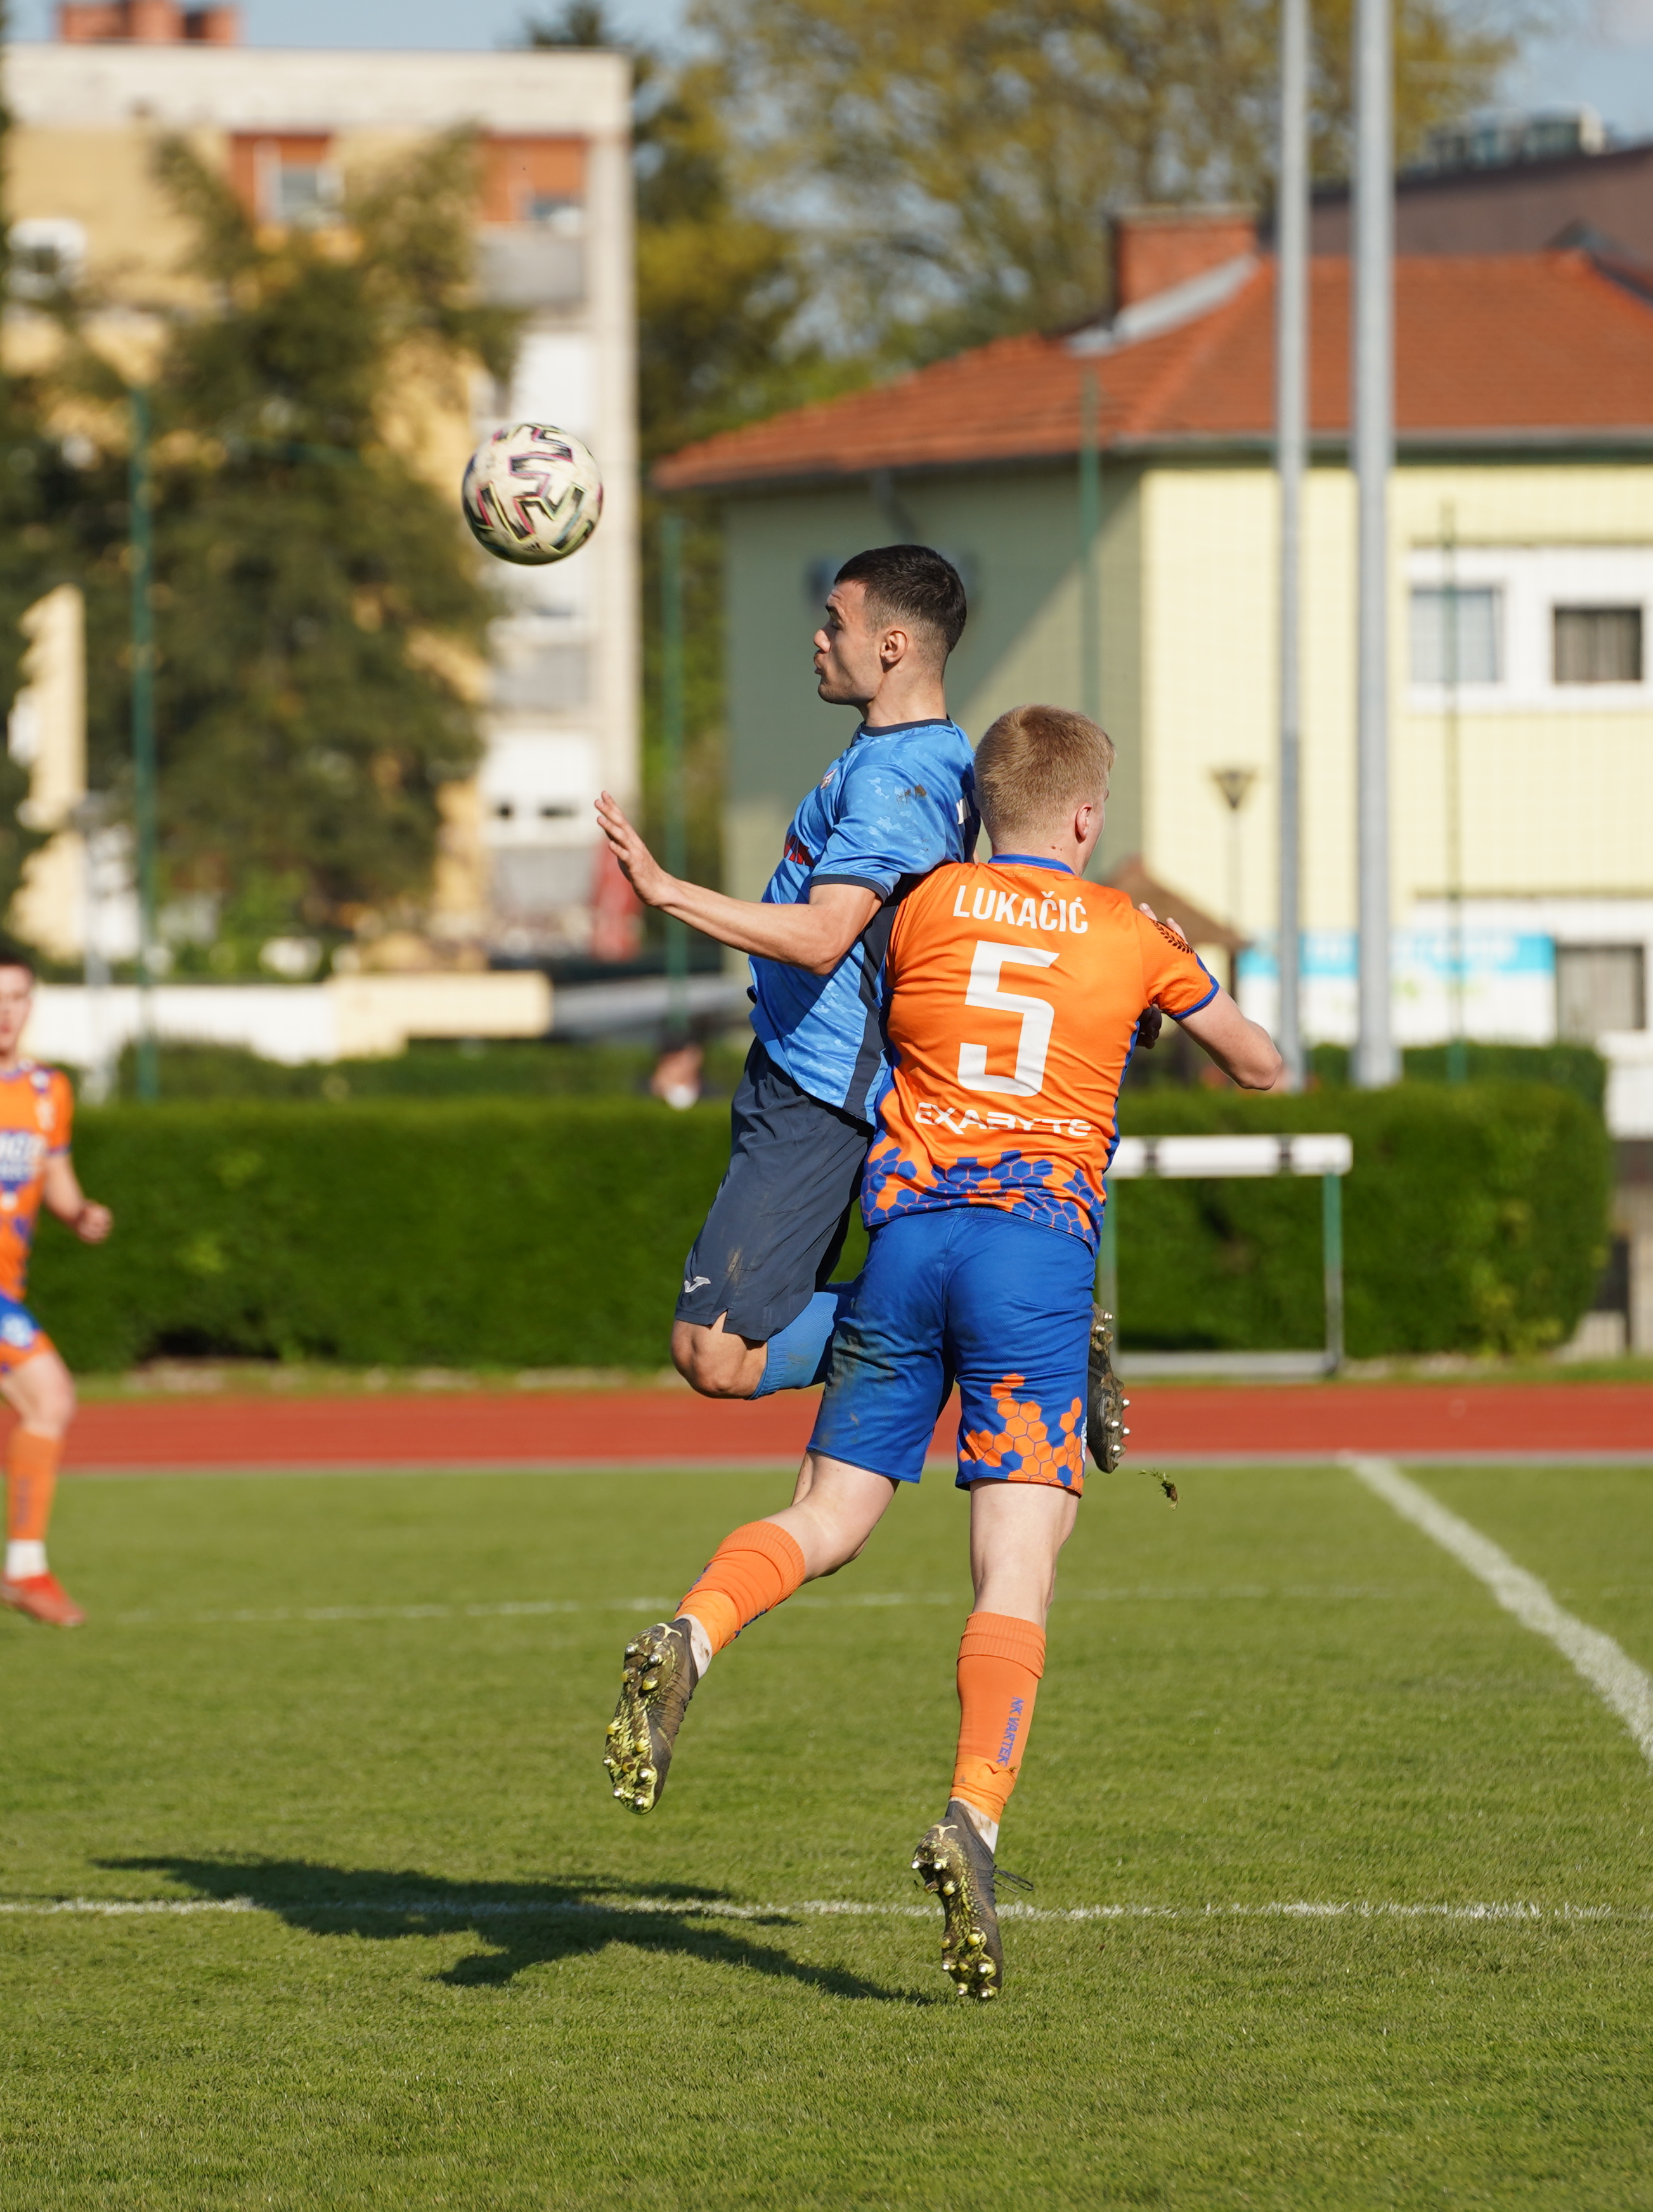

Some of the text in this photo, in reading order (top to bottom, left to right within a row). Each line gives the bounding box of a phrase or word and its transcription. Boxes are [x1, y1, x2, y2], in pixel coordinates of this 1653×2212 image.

[952, 885, 1088, 934] LUKAČIĆ
[957, 940, 1060, 1097] 5
[915, 1102, 1091, 1136] EXABYTE
[996, 1696, 1024, 1767] NK VARTEK
